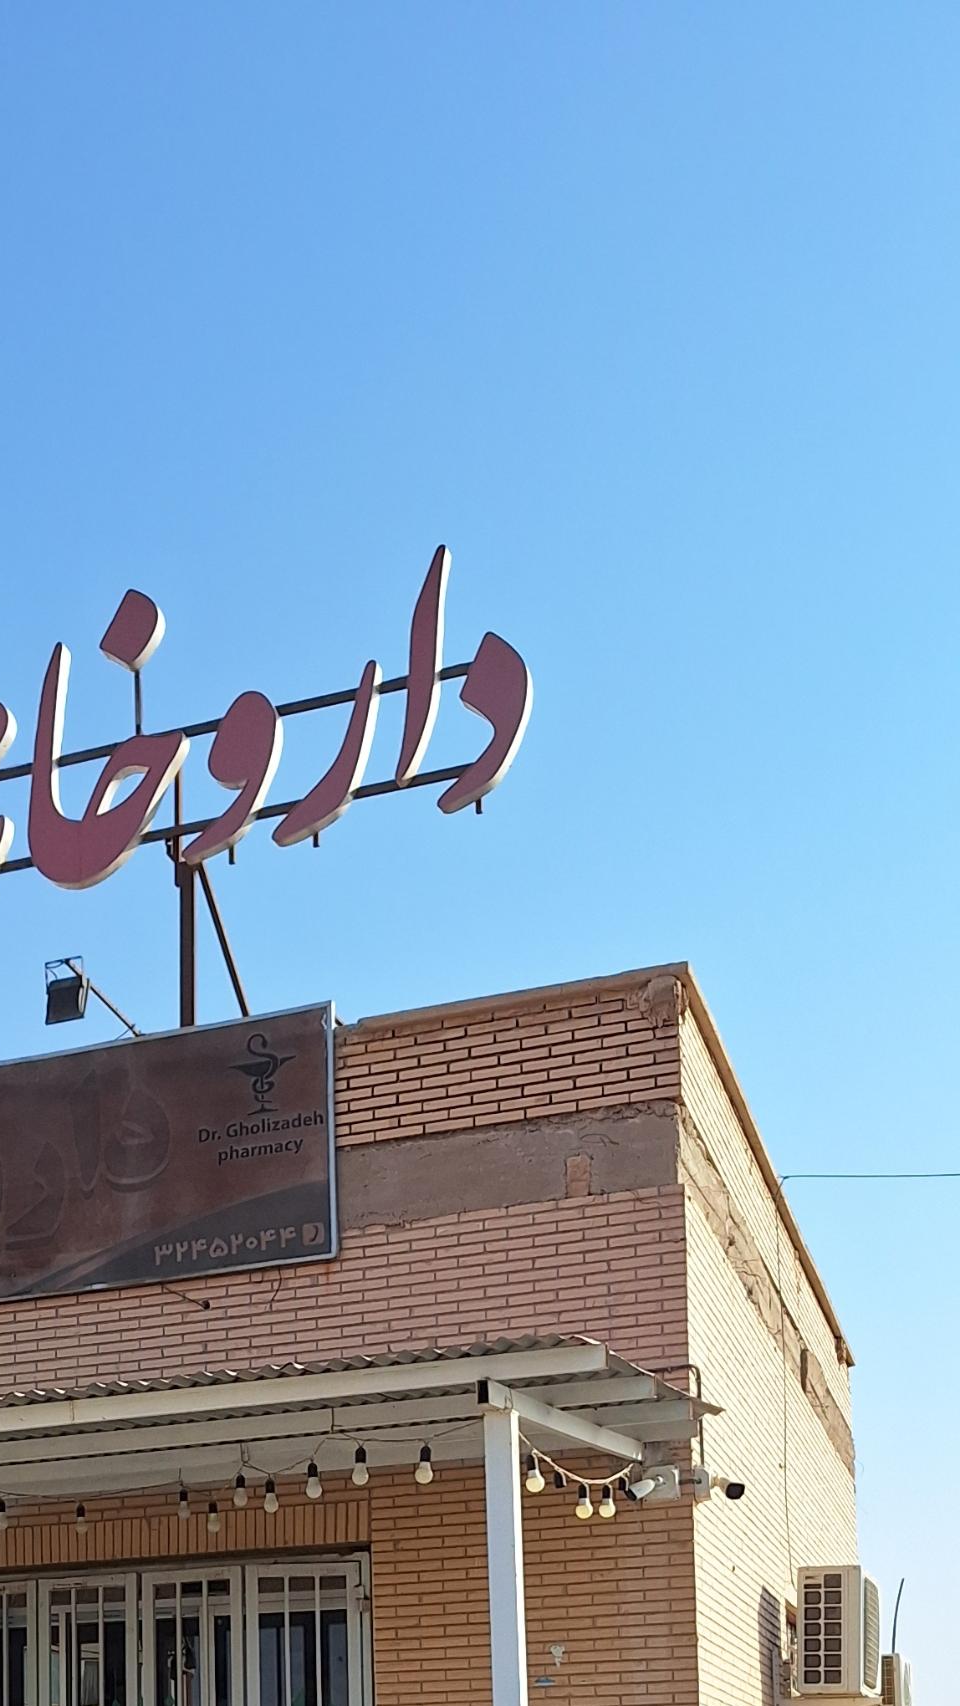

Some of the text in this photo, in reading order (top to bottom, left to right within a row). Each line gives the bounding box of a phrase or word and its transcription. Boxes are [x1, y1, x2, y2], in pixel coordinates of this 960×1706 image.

[198, 1110, 325, 1144] Dr. Gholizadeh
[217, 1138, 304, 1167] pharmacy
